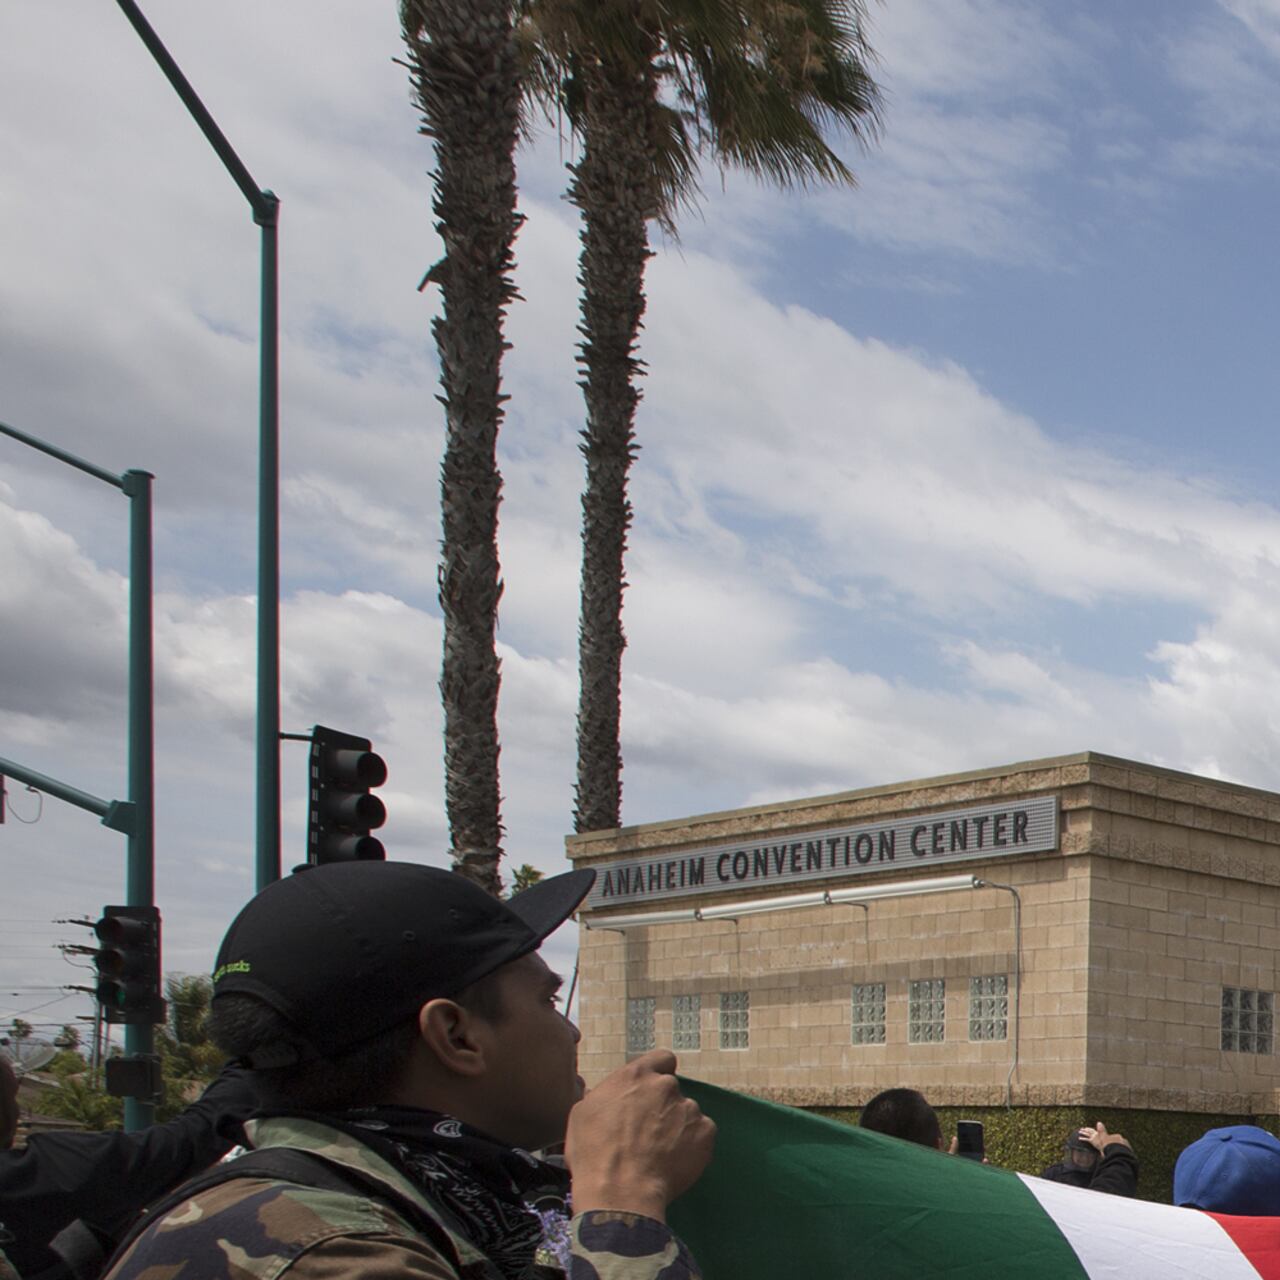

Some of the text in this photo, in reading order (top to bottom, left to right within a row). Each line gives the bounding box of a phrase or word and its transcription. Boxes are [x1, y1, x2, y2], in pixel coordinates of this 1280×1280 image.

[602, 810, 1029, 897] ANAHEIM CONVENTION CENTER
